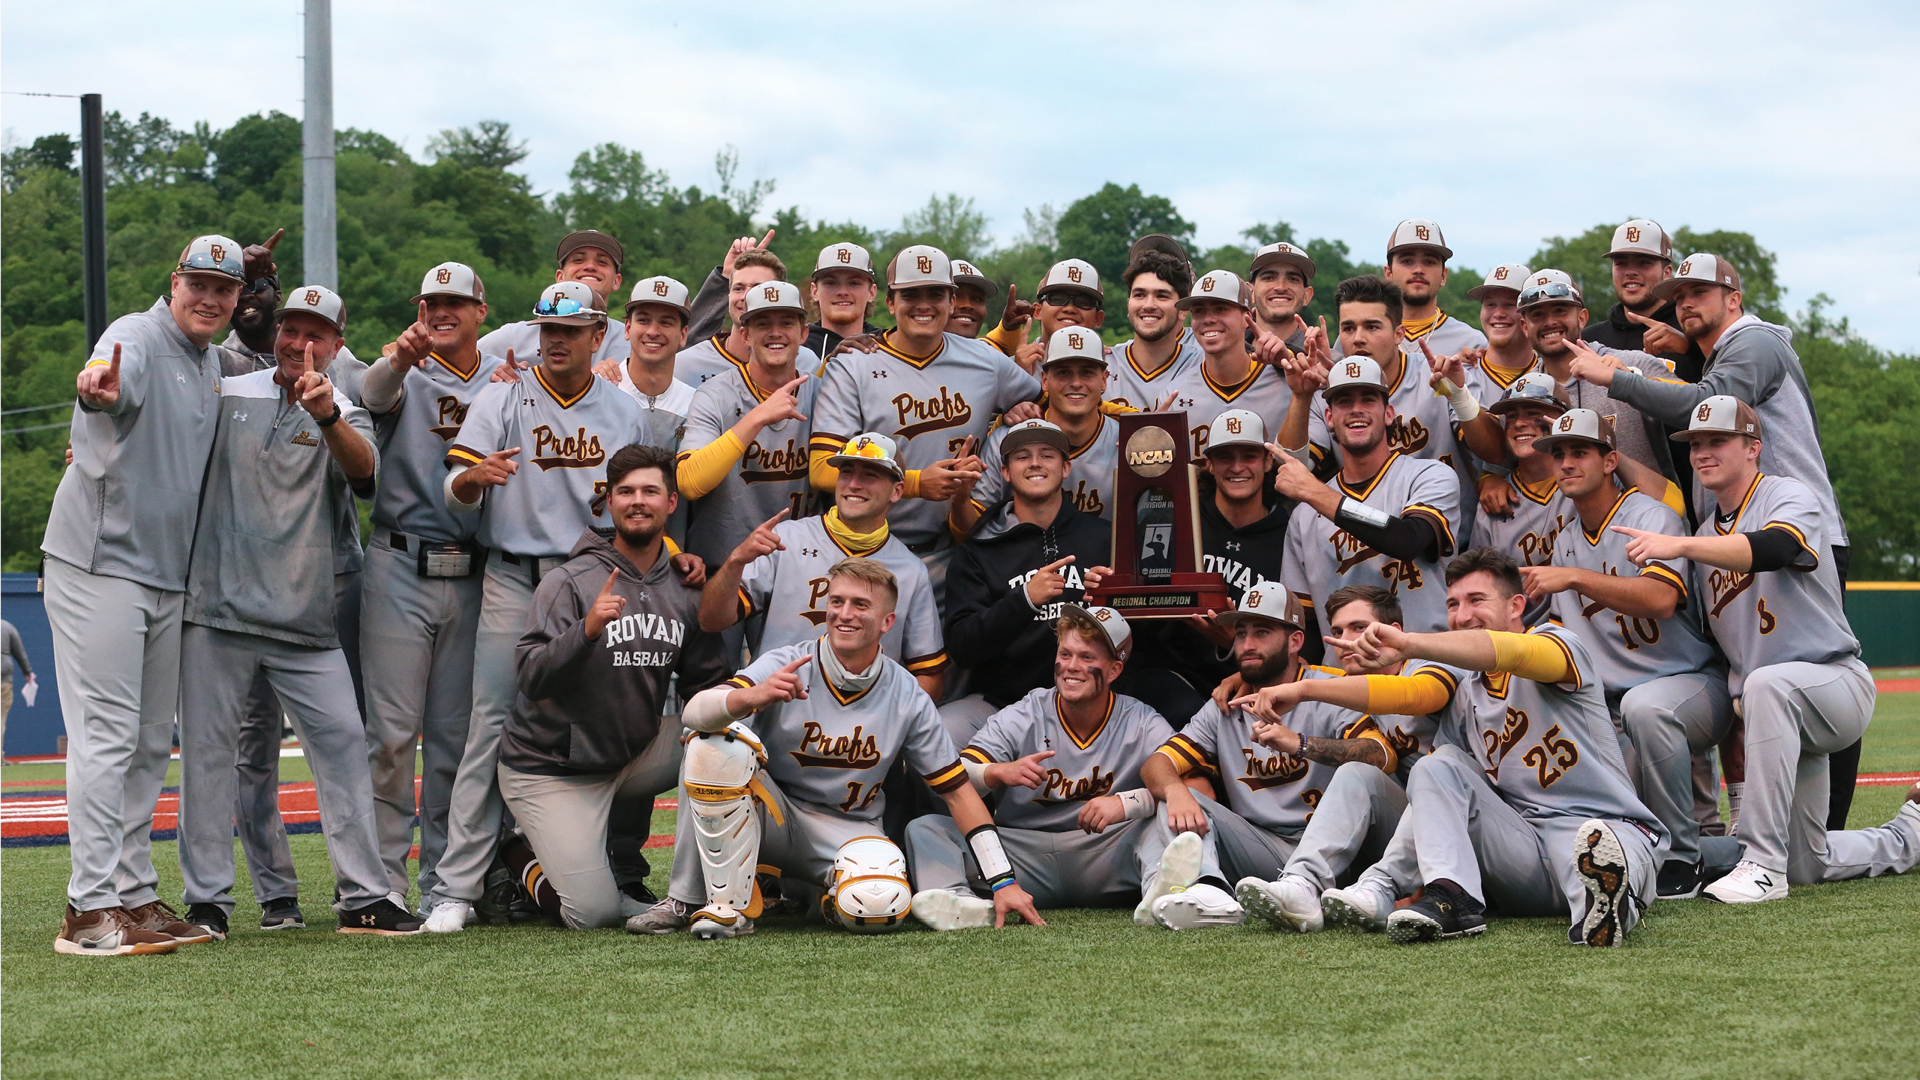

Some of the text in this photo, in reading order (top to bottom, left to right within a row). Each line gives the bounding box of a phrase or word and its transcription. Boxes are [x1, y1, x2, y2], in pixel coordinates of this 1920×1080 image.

[1416, 225, 1430, 241] RU
[1626, 226, 1640, 243] RU
[211, 244, 226, 263] RU
[838, 249, 852, 263] RU
[917, 255, 932, 274] RU
[1680, 261, 1692, 276] RU
[436, 268, 452, 284] RU
[1068, 267, 1082, 283] RU
[1494, 267, 1509, 280] RU
[653, 281, 669, 297] RU
[1201, 277, 1216, 292] RU
[304, 290, 322, 306] RU
[764, 287, 779, 302] RU
[1068, 333, 1084, 350] RU
[1345, 362, 1361, 378] RU
[892, 386, 969, 426] Profs
[1697, 403, 1711, 422] RU
[1226, 417, 1242, 434] RU
[1558, 415, 1573, 432] RU
[533, 425, 603, 461] Profs
[742, 439, 808, 474] Profs
[1129, 450, 1173, 465] NCAA
[1381, 560, 1423, 597] 24
[1113, 595, 1191, 607] REGIONAL CHAMPION
[1247, 590, 1263, 608] RU
[1095, 608, 1112, 622] RU
[605, 613, 685, 649] ROWAN
[1616, 614, 1660, 650] 10
[799, 721, 879, 763] Profs
[1523, 723, 1588, 790] 25
